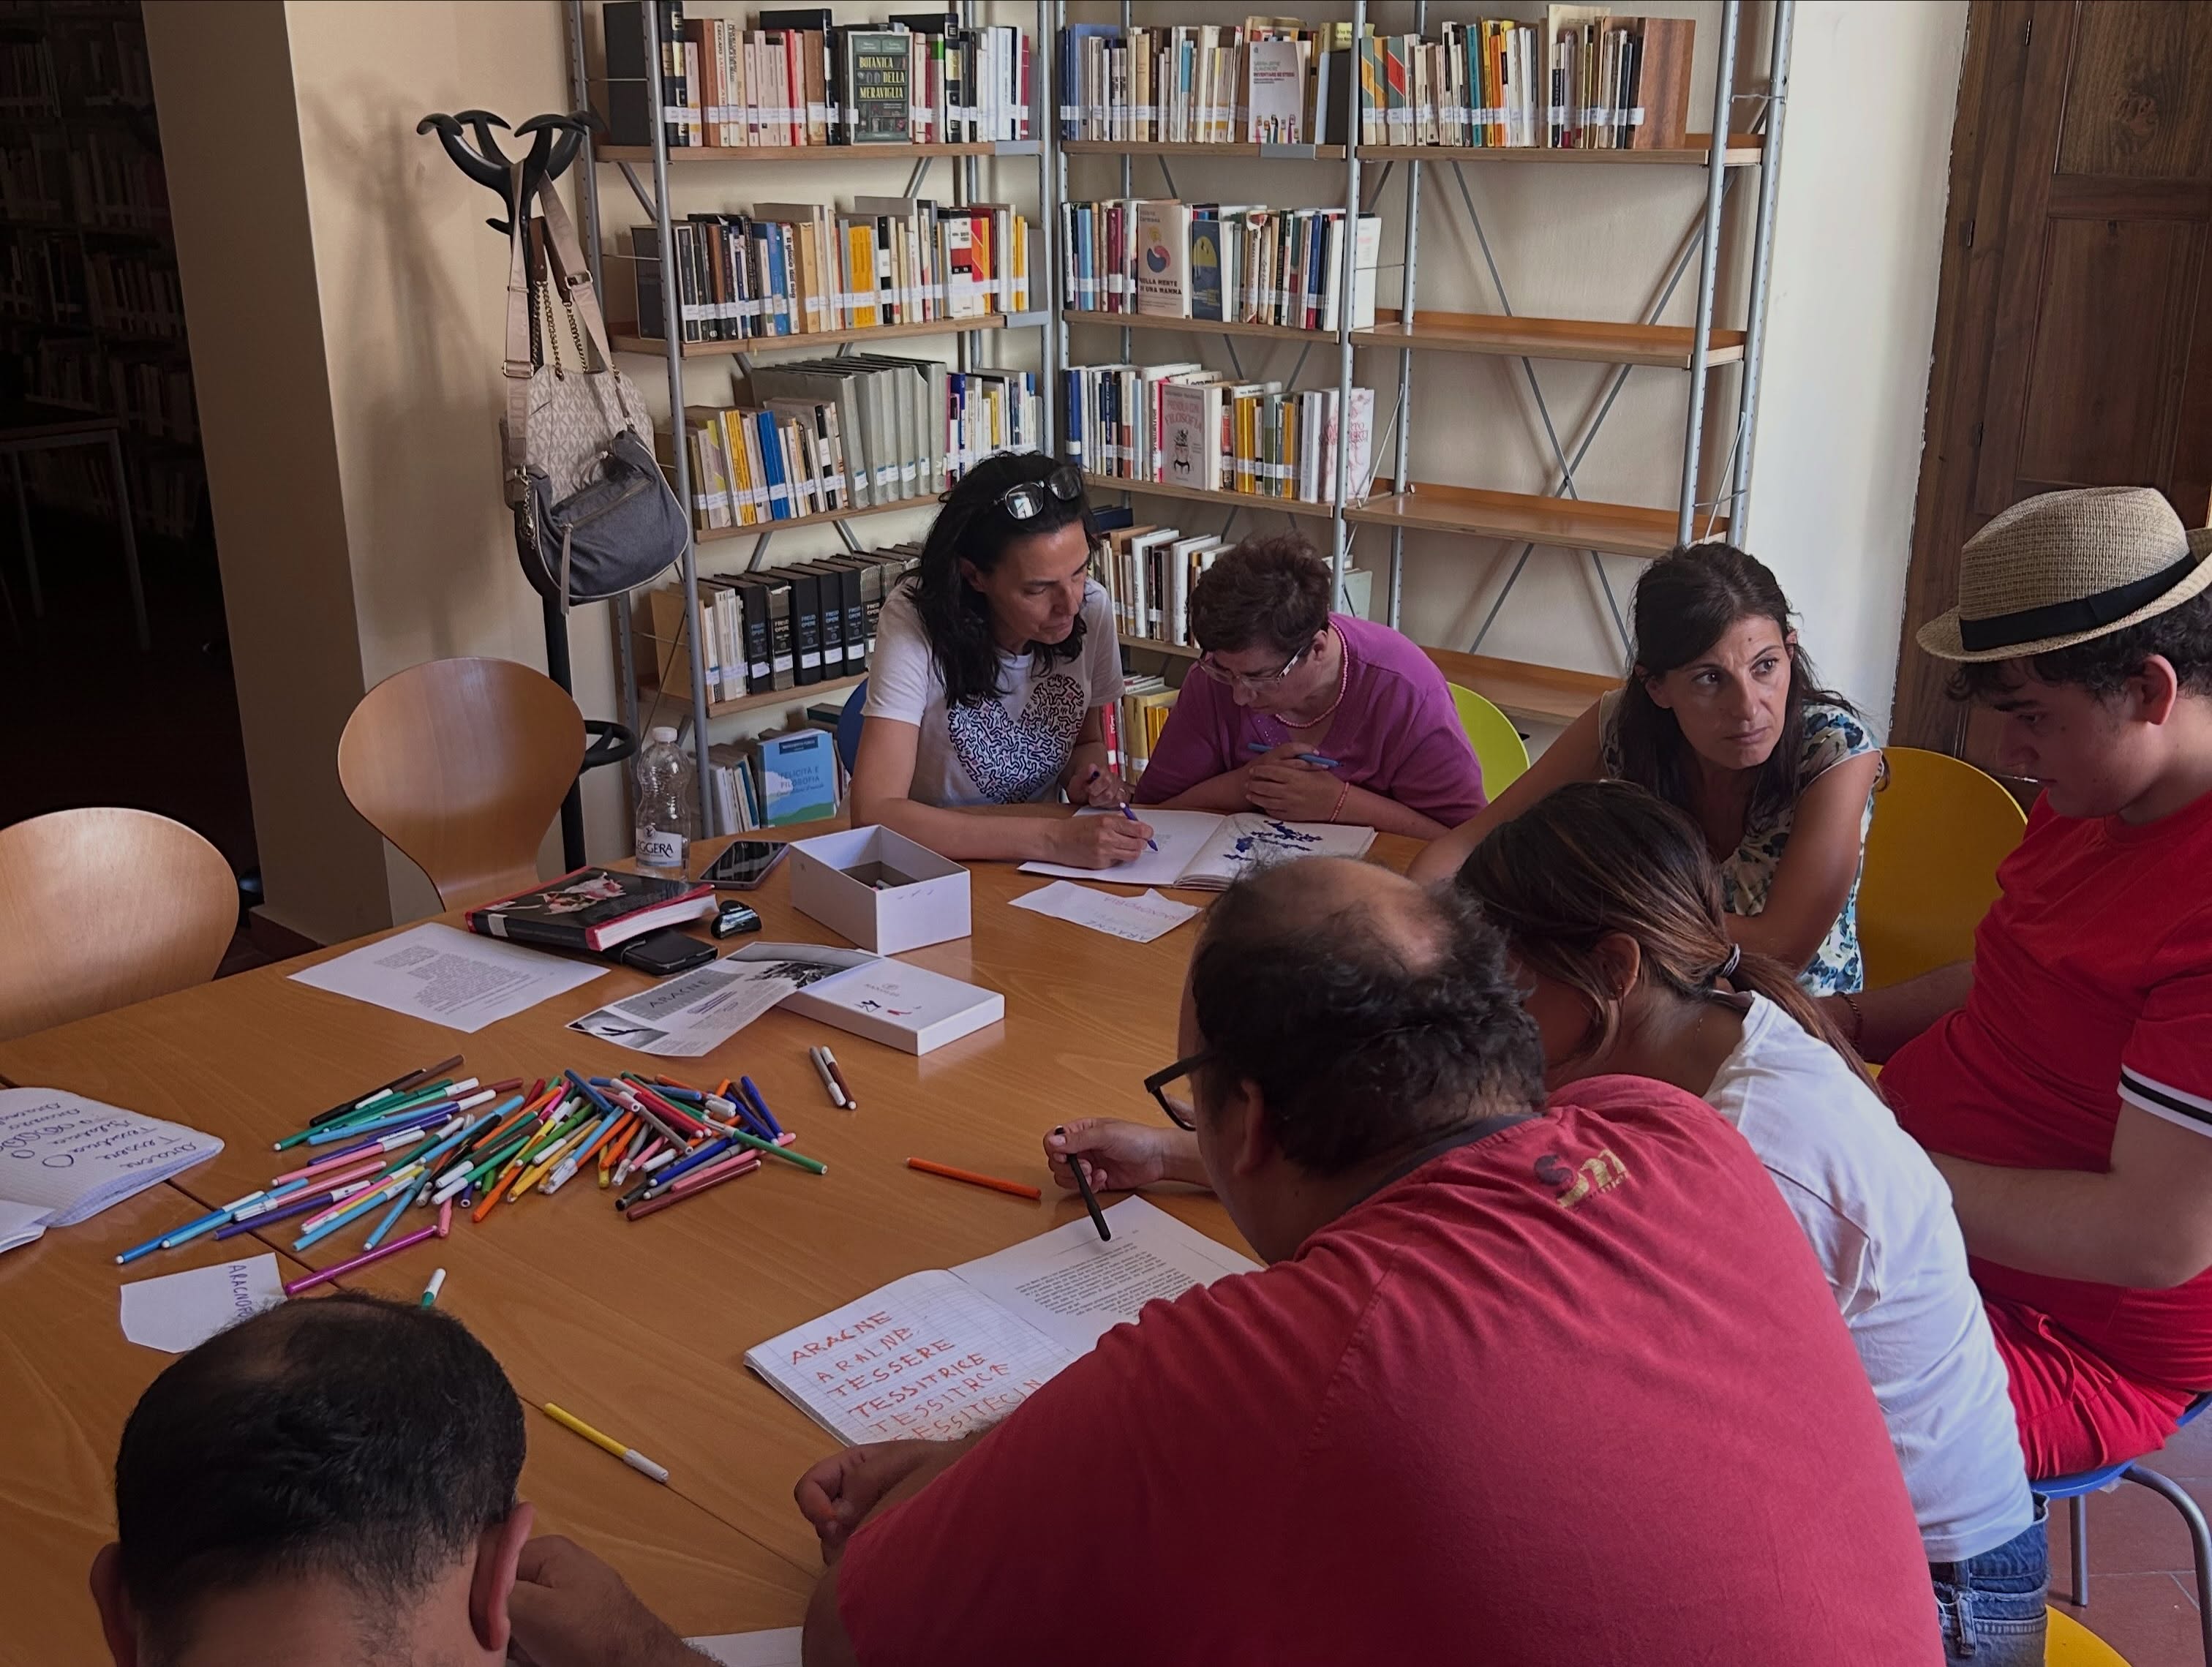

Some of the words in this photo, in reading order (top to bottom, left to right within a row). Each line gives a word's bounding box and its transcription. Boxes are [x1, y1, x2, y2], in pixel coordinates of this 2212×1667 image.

[859, 56, 894, 68] BOTANICA
[882, 71, 905, 83] DELLA
[859, 86, 903, 99] MERAVIGLIA
[650, 979, 710, 1009] ARACNE
[791, 1311, 892, 1365] ARACNE
[827, 1339, 955, 1397] TESSERE
[849, 1352, 988, 1418] TESSITRICE
